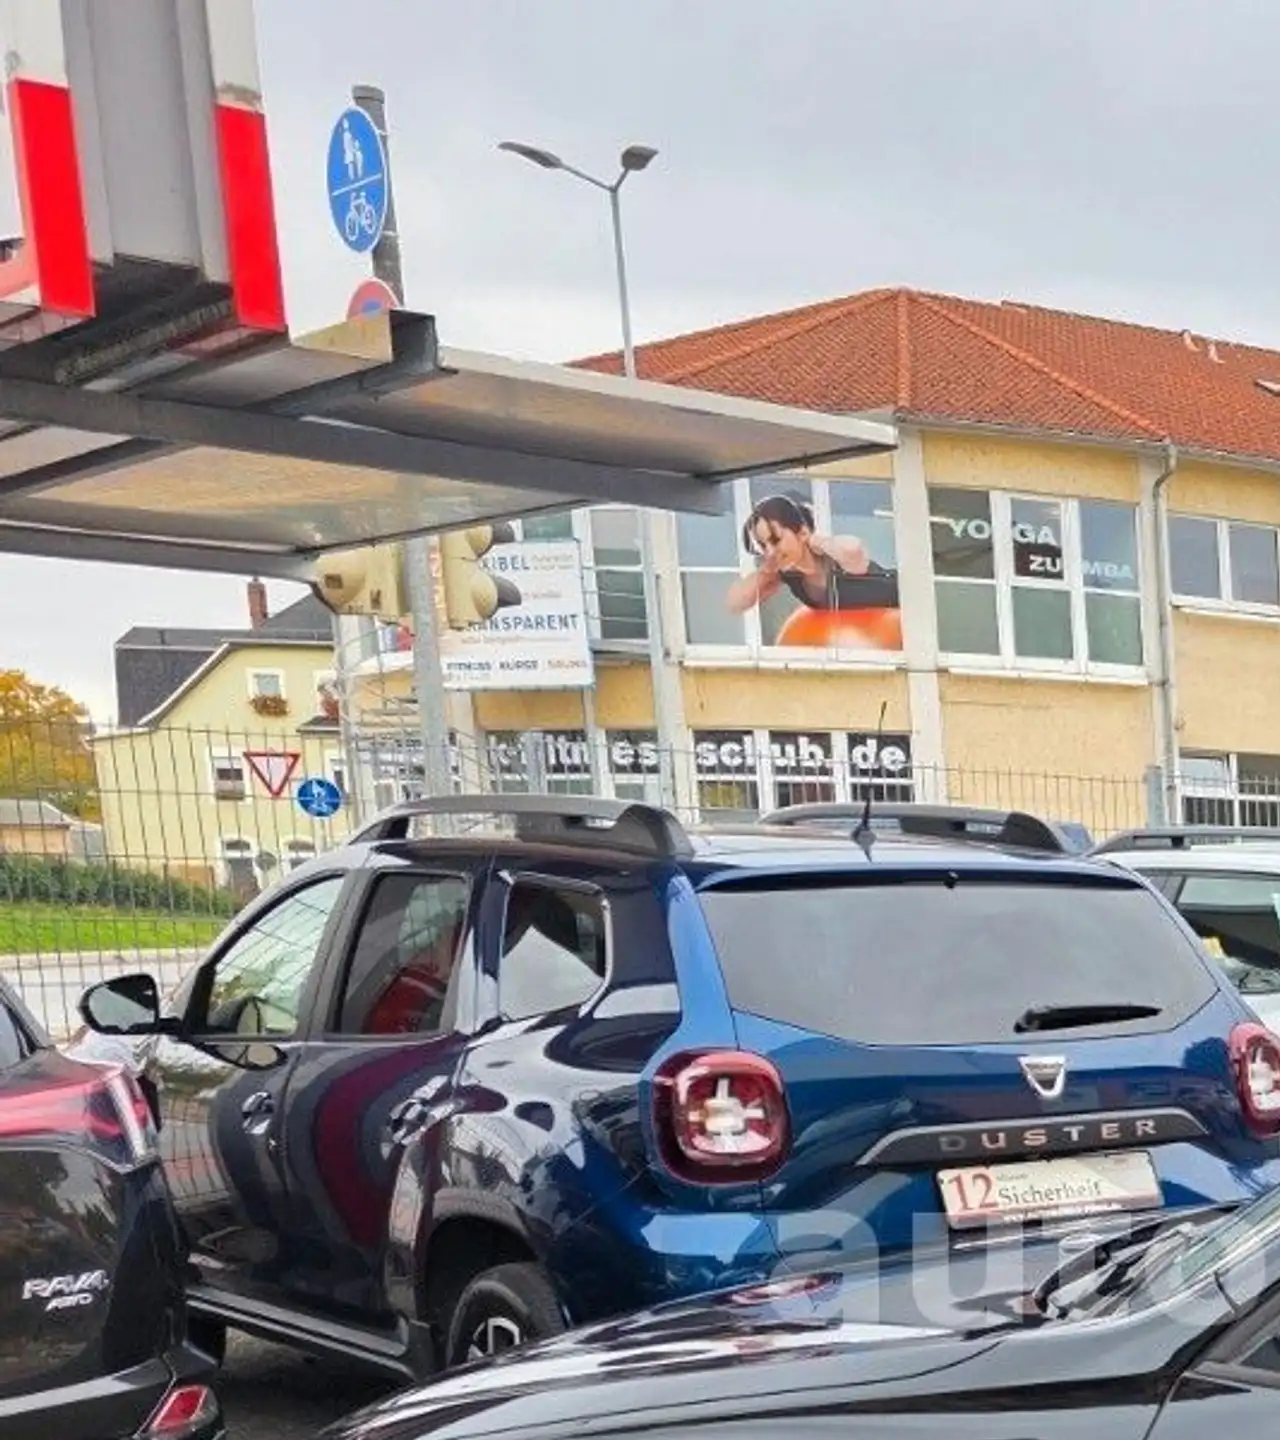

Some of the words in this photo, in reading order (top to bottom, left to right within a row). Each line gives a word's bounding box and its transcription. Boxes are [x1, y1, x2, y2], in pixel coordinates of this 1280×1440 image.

[950, 518, 1058, 545] YOGA
[1029, 555, 1134, 579] ZUMBA
[938, 1118, 1157, 1151] DUSTER
[949, 1172, 998, 1211] 12
[998, 1180, 1100, 1206] Sicherheit
